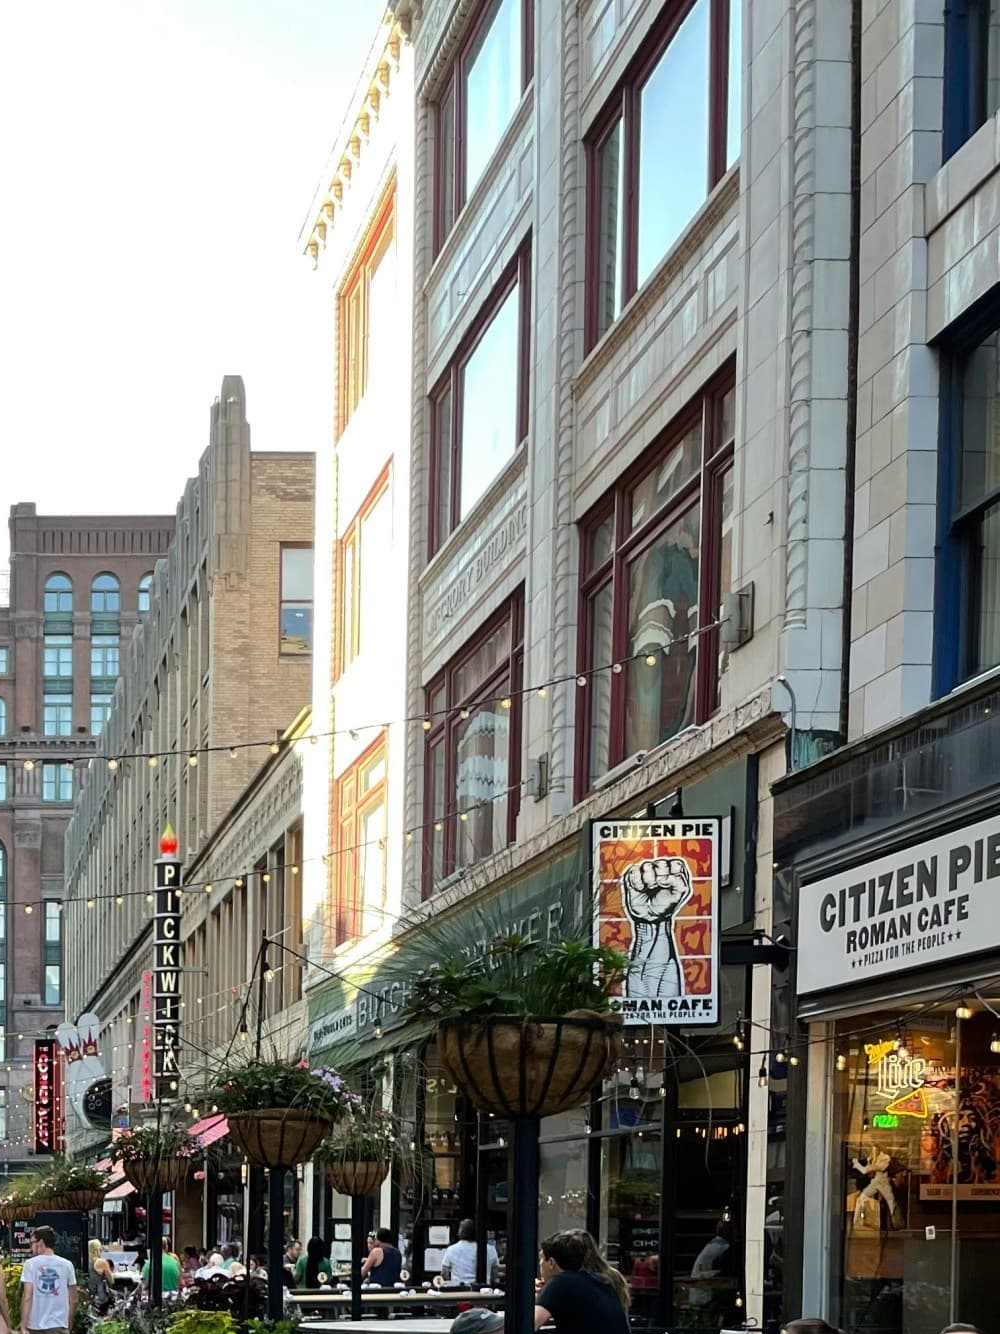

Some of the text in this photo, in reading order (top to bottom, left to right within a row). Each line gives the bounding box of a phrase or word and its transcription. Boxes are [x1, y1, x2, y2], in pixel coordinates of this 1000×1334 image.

[600, 824, 713, 839] CITIZEN PIE
[819, 832, 1000, 933] CITIZEN PIE
[846, 894, 970, 953] ROMAN CAFE
[161, 865, 176, 1071] PICKWICK
[863, 931, 946, 967] PIZZA FOR THE PEOPLE
[609, 999, 713, 1012] OMAN CAFE
[876, 1054, 927, 1099] Lite
[37, 1054, 49, 1147] CORNER ALLEY
[872, 1113, 899, 1128] PIZZA
